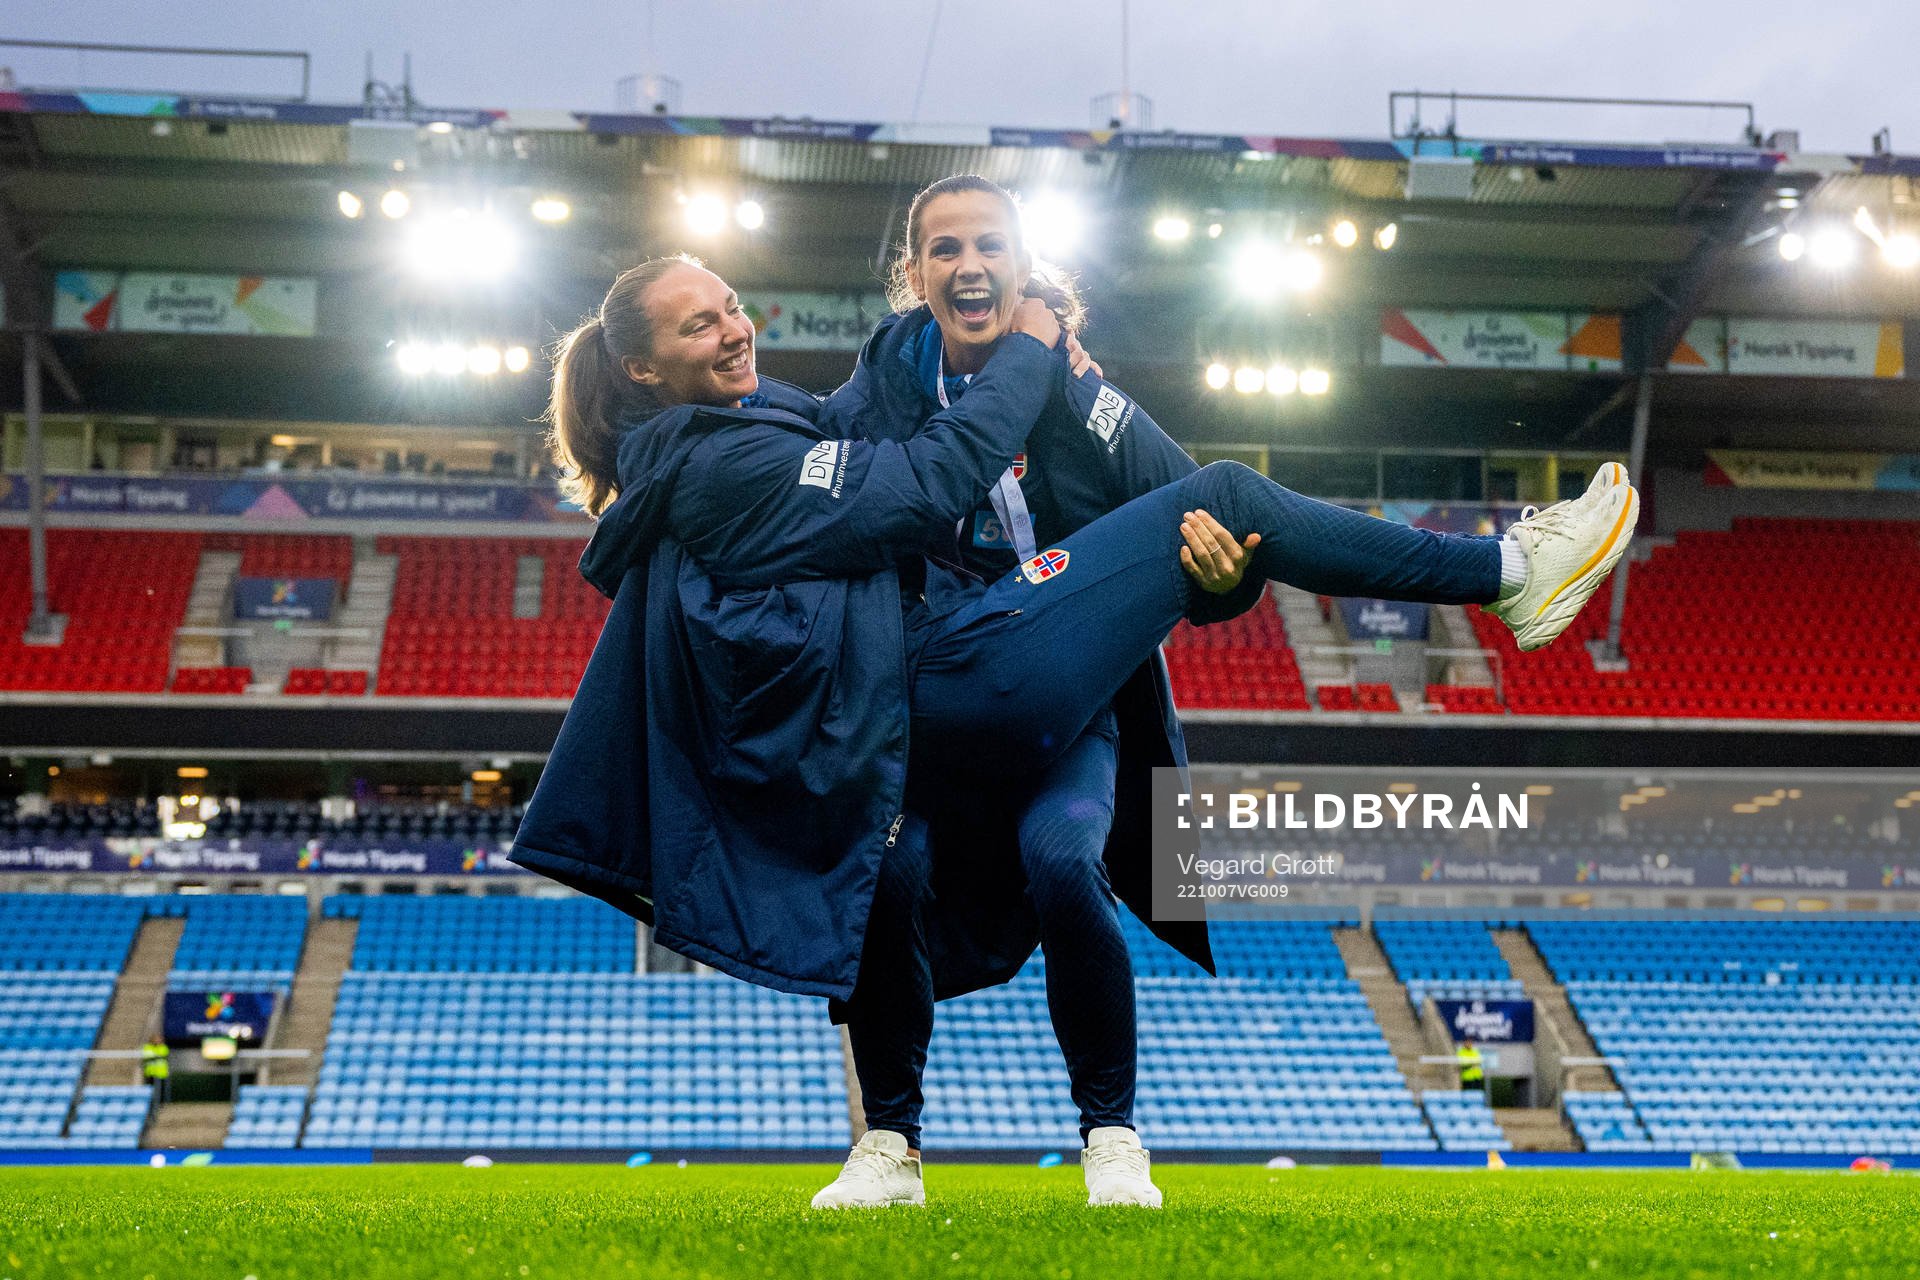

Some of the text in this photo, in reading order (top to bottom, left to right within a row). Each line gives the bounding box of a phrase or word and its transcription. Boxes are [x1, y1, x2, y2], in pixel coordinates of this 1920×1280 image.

[793, 311, 873, 338] Norsk
[32, 846, 92, 869] Tipping
[202, 848, 260, 870] Tipping
[322, 849, 427, 872] Norsk Tipping
[1444, 861, 1541, 883] Norsk Tipping
[1752, 864, 1849, 888] Norsk Tipping
